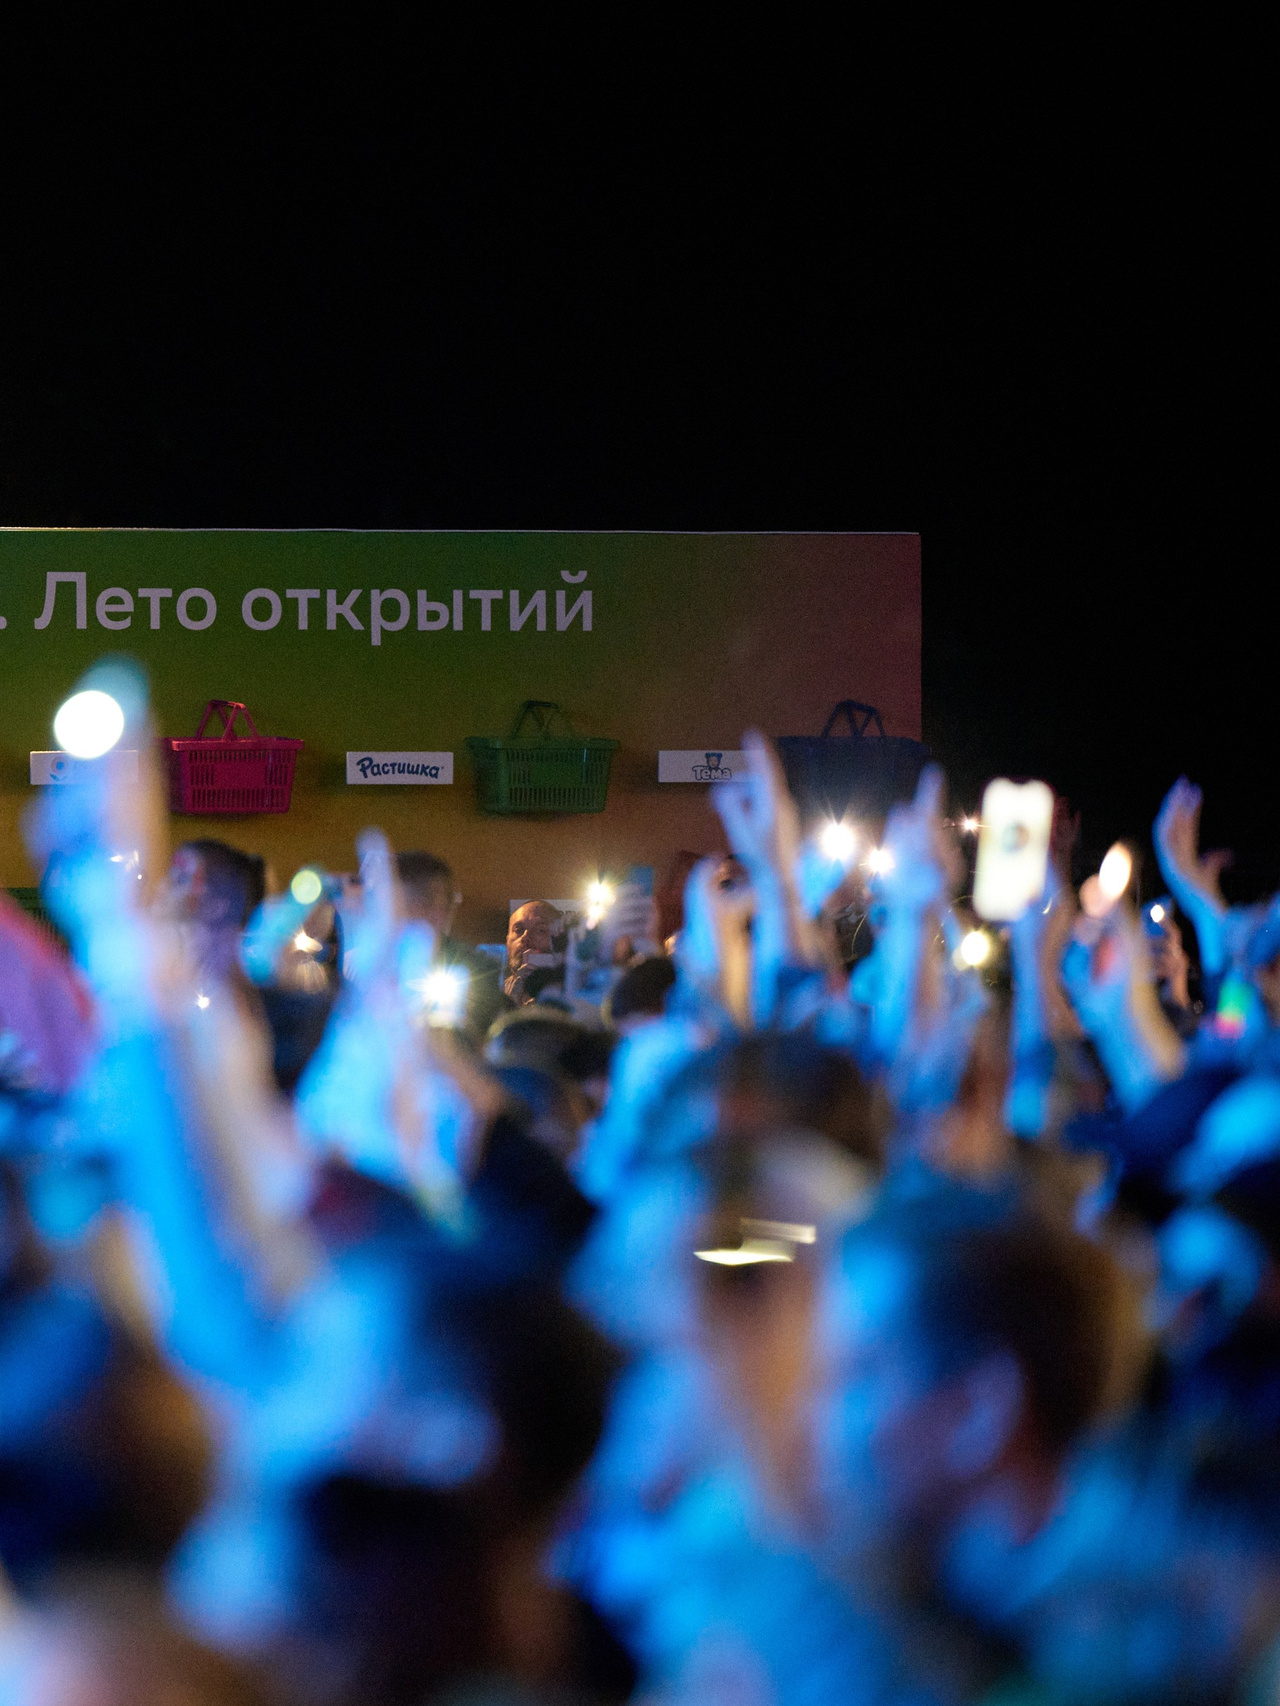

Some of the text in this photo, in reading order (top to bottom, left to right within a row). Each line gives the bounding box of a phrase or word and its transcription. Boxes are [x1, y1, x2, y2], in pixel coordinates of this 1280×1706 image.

[34, 571, 217, 630] Лето
[241, 570, 593, 646] открытий
[356, 756, 440, 779] Растишка
